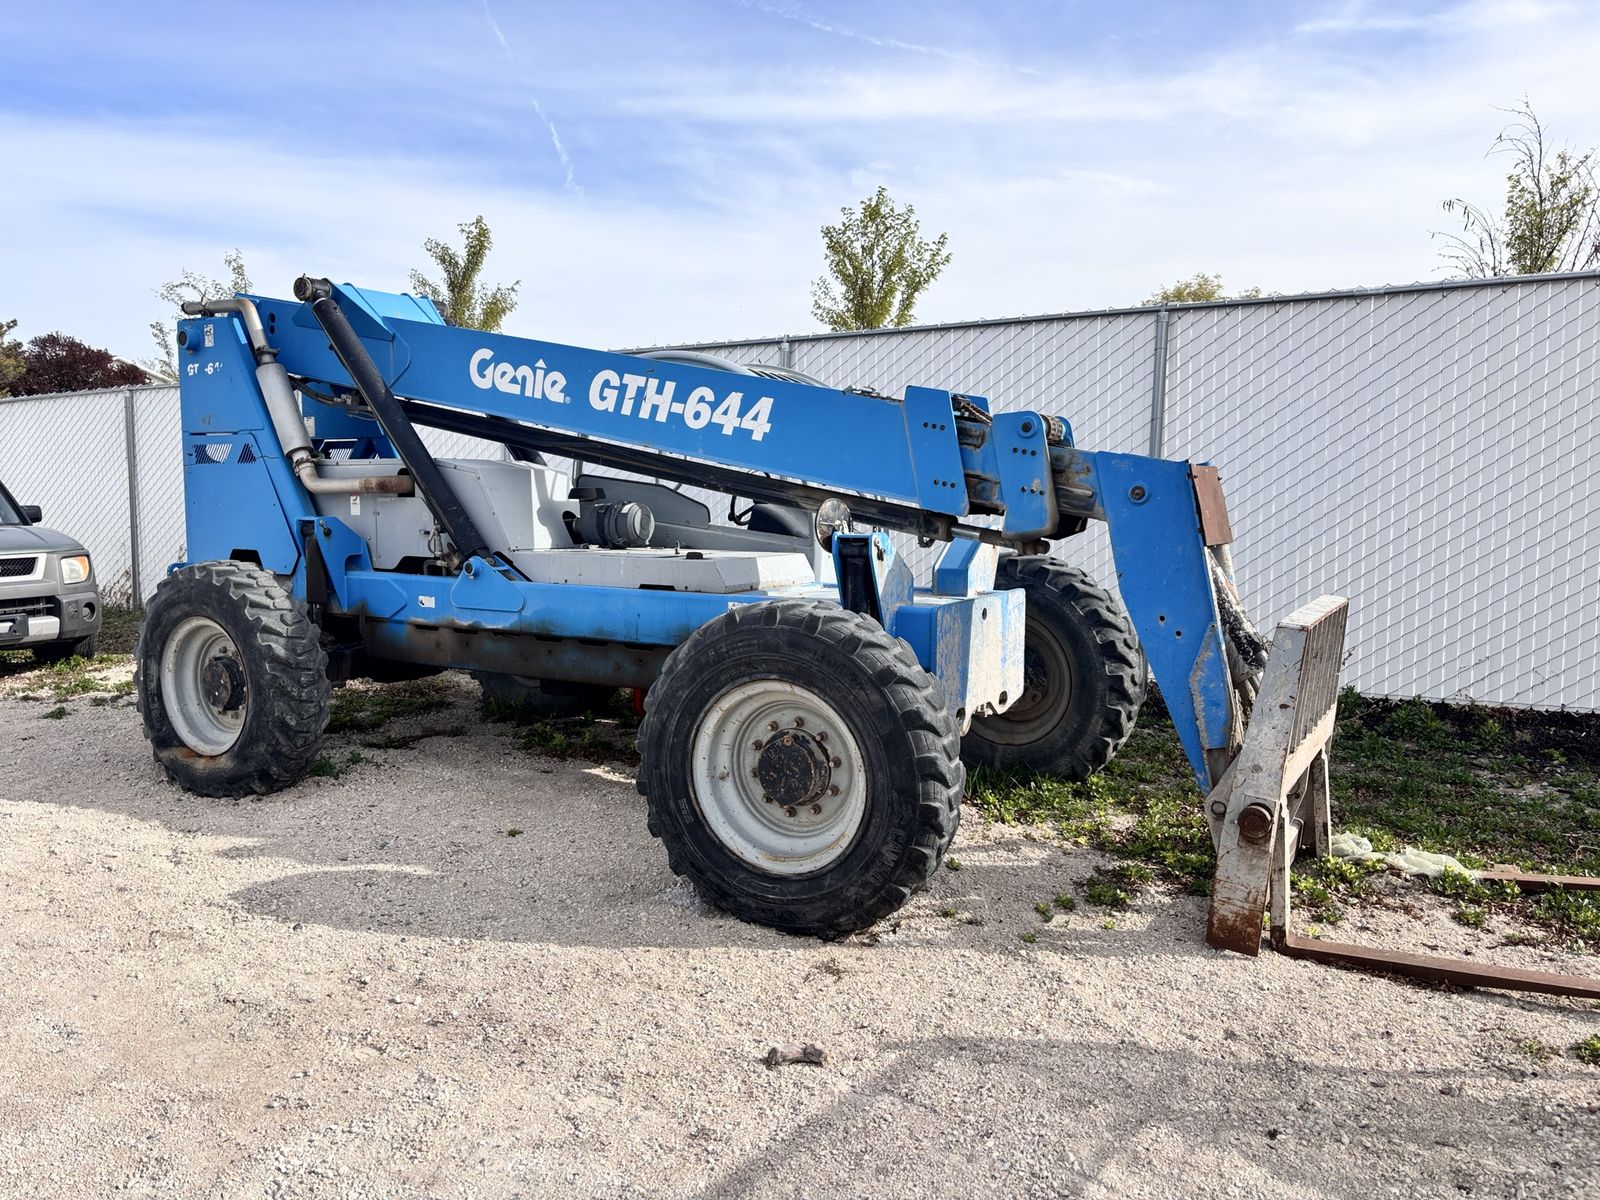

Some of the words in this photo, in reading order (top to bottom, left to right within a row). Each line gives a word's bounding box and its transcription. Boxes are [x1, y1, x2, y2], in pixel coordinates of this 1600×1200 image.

[187, 361, 224, 376] GT-6
[469, 348, 567, 404] Genie
[588, 369, 775, 442] GTH-644
